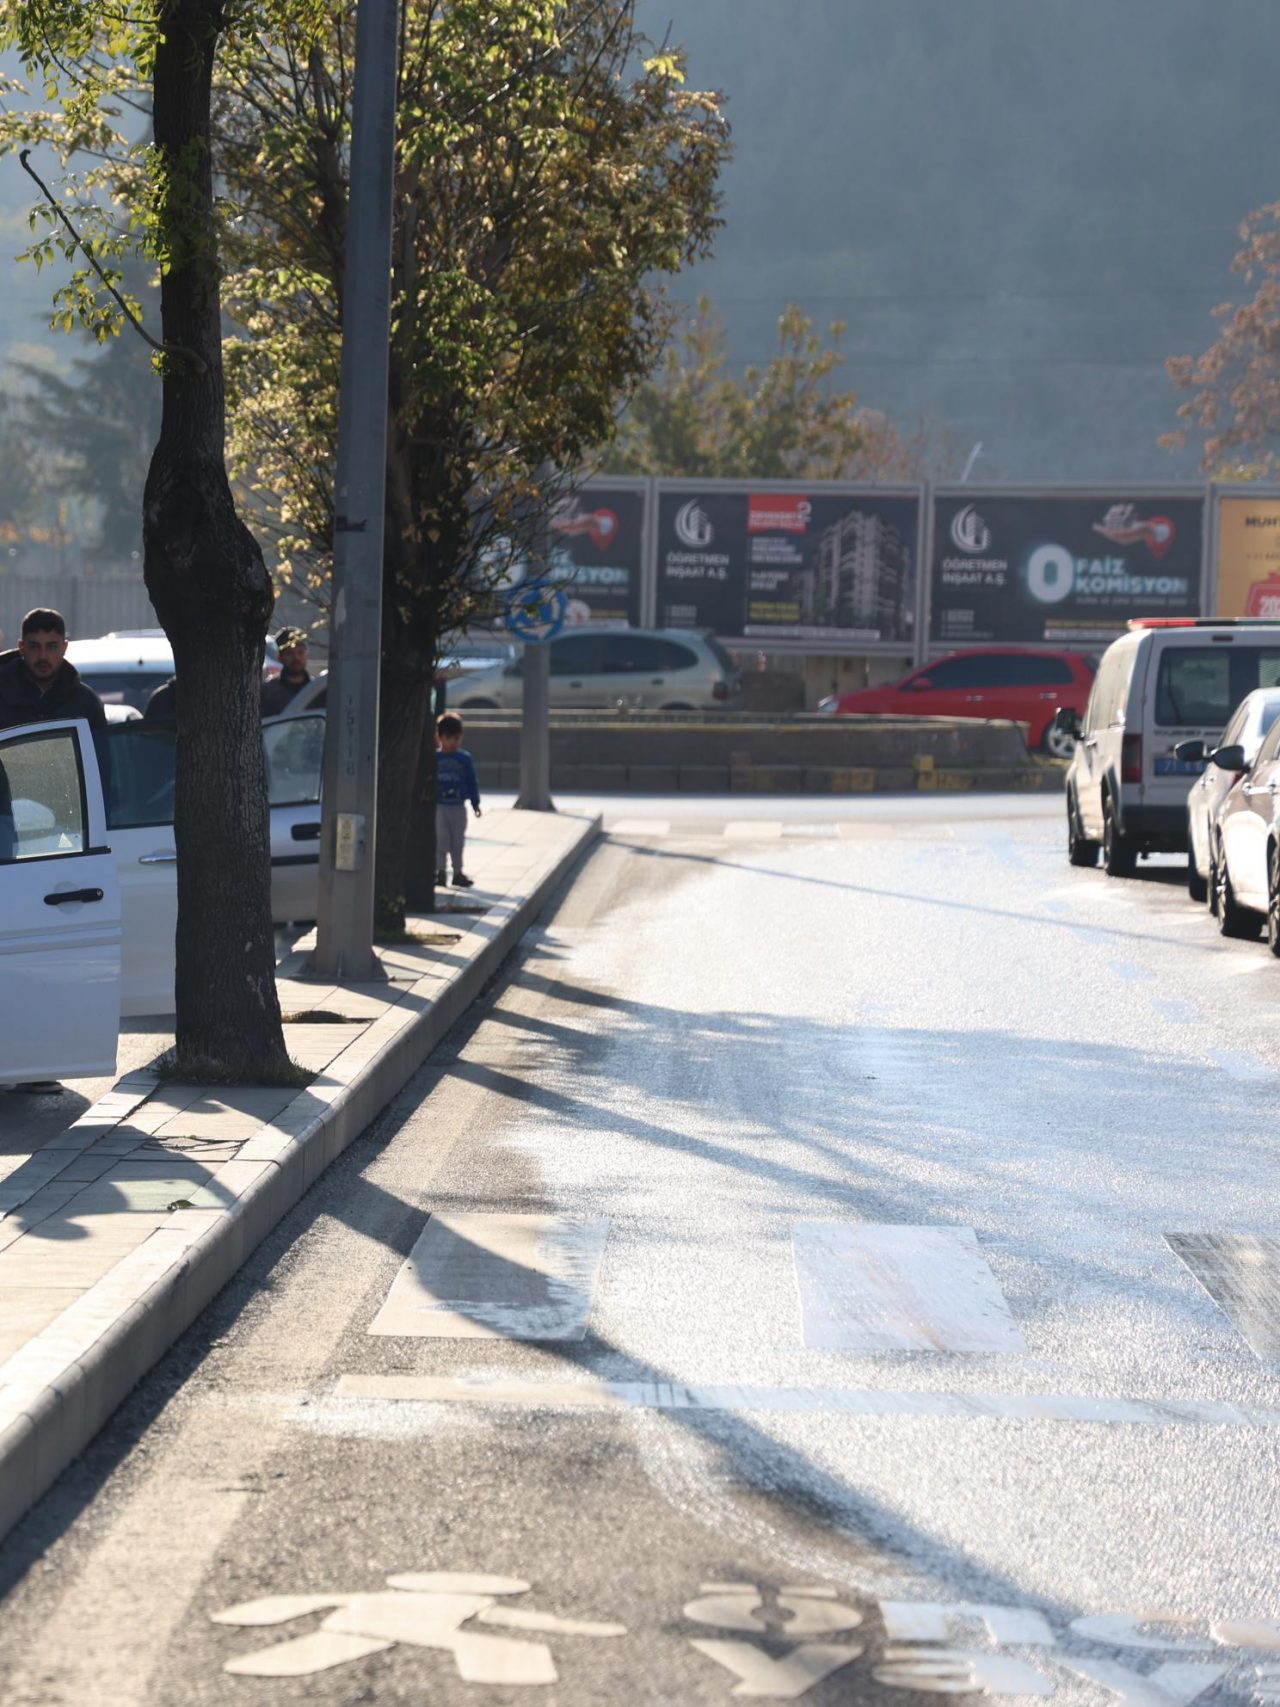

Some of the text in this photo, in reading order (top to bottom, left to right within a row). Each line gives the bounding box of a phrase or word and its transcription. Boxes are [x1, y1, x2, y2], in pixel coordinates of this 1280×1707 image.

[666, 550, 729, 565] ÖĞRETMEN
[942, 558, 1007, 572] ÖĞRETMEN
[666, 566, 705, 581] İNŞAAT
[942, 572, 982, 586] İNŞAAT
[1027, 544, 1126, 603] 0 FAİZ
[1076, 575, 1188, 594] KOMİSYON
